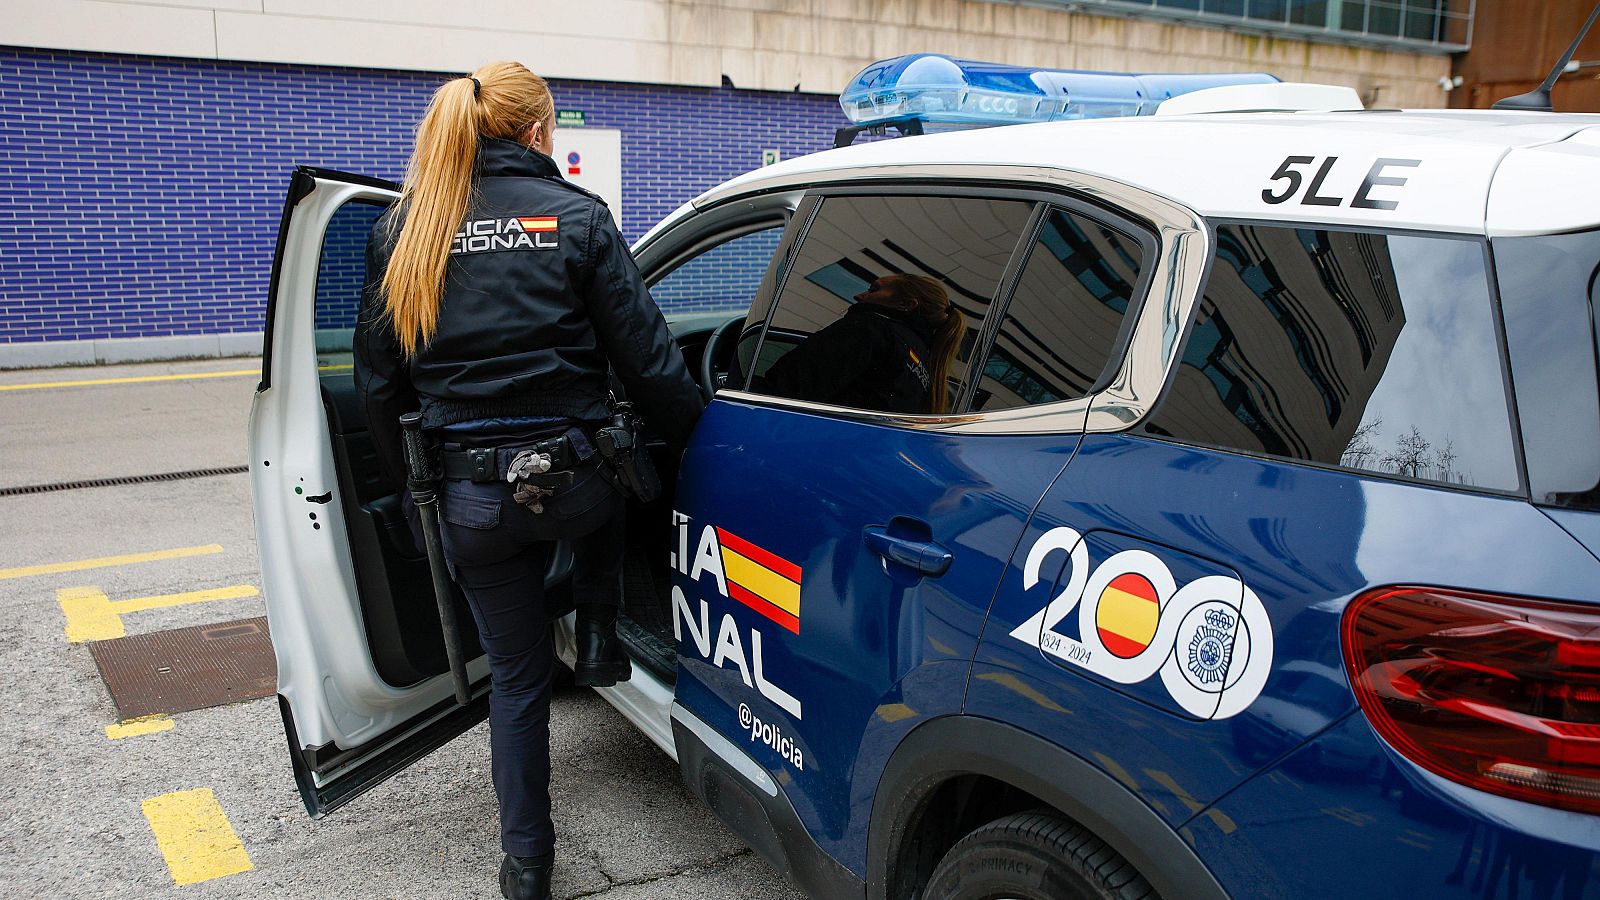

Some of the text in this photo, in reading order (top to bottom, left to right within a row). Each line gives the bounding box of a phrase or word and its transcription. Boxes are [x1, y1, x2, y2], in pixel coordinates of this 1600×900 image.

[1261, 155, 1422, 211] 5LE
[670, 509, 729, 598] IA
[1008, 526, 1274, 721] 200
[1040, 632, 1062, 652] 1824
[1067, 643, 1092, 665] 2024
[738, 702, 804, 771] @policia
[981, 856, 1033, 876] PRIMACY
